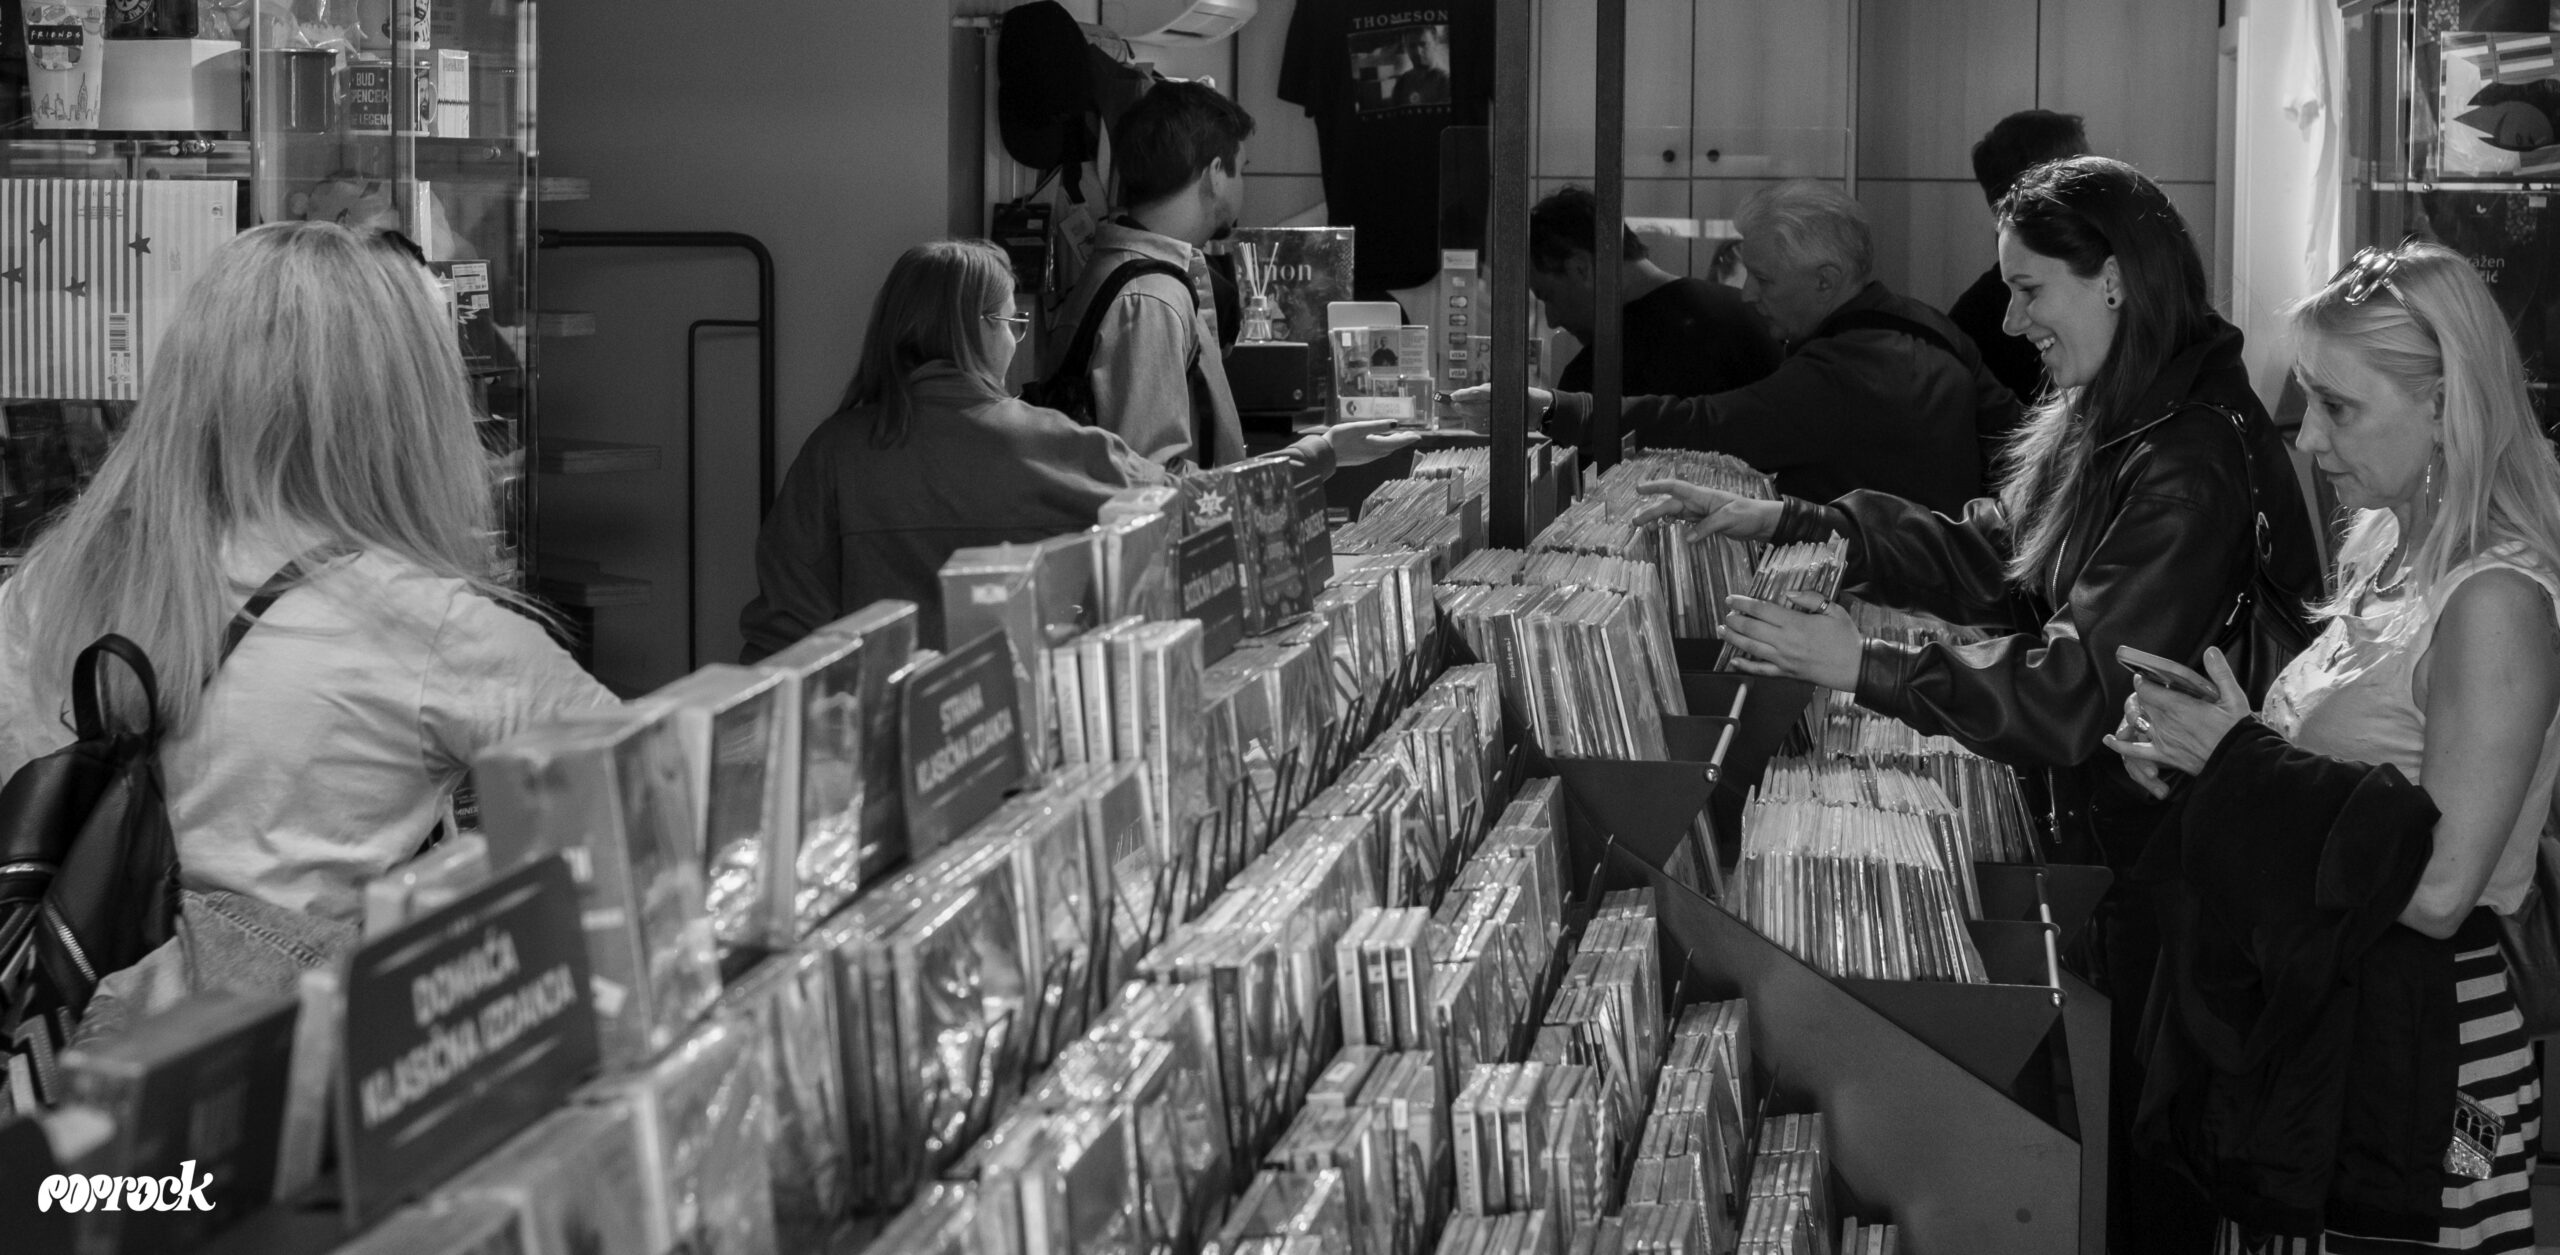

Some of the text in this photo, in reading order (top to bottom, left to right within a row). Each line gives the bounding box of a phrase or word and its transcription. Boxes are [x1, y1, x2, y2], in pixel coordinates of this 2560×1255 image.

[1353, 10, 1449, 30] THOMPSON
[355, 71, 375, 87] BUD
[350, 88, 389, 103] PENCER
[915, 735, 969, 797] KLASIČNA
[967, 705, 1015, 758] IZDANJA
[360, 963, 578, 1131] KLASIČNA IZDANJA
